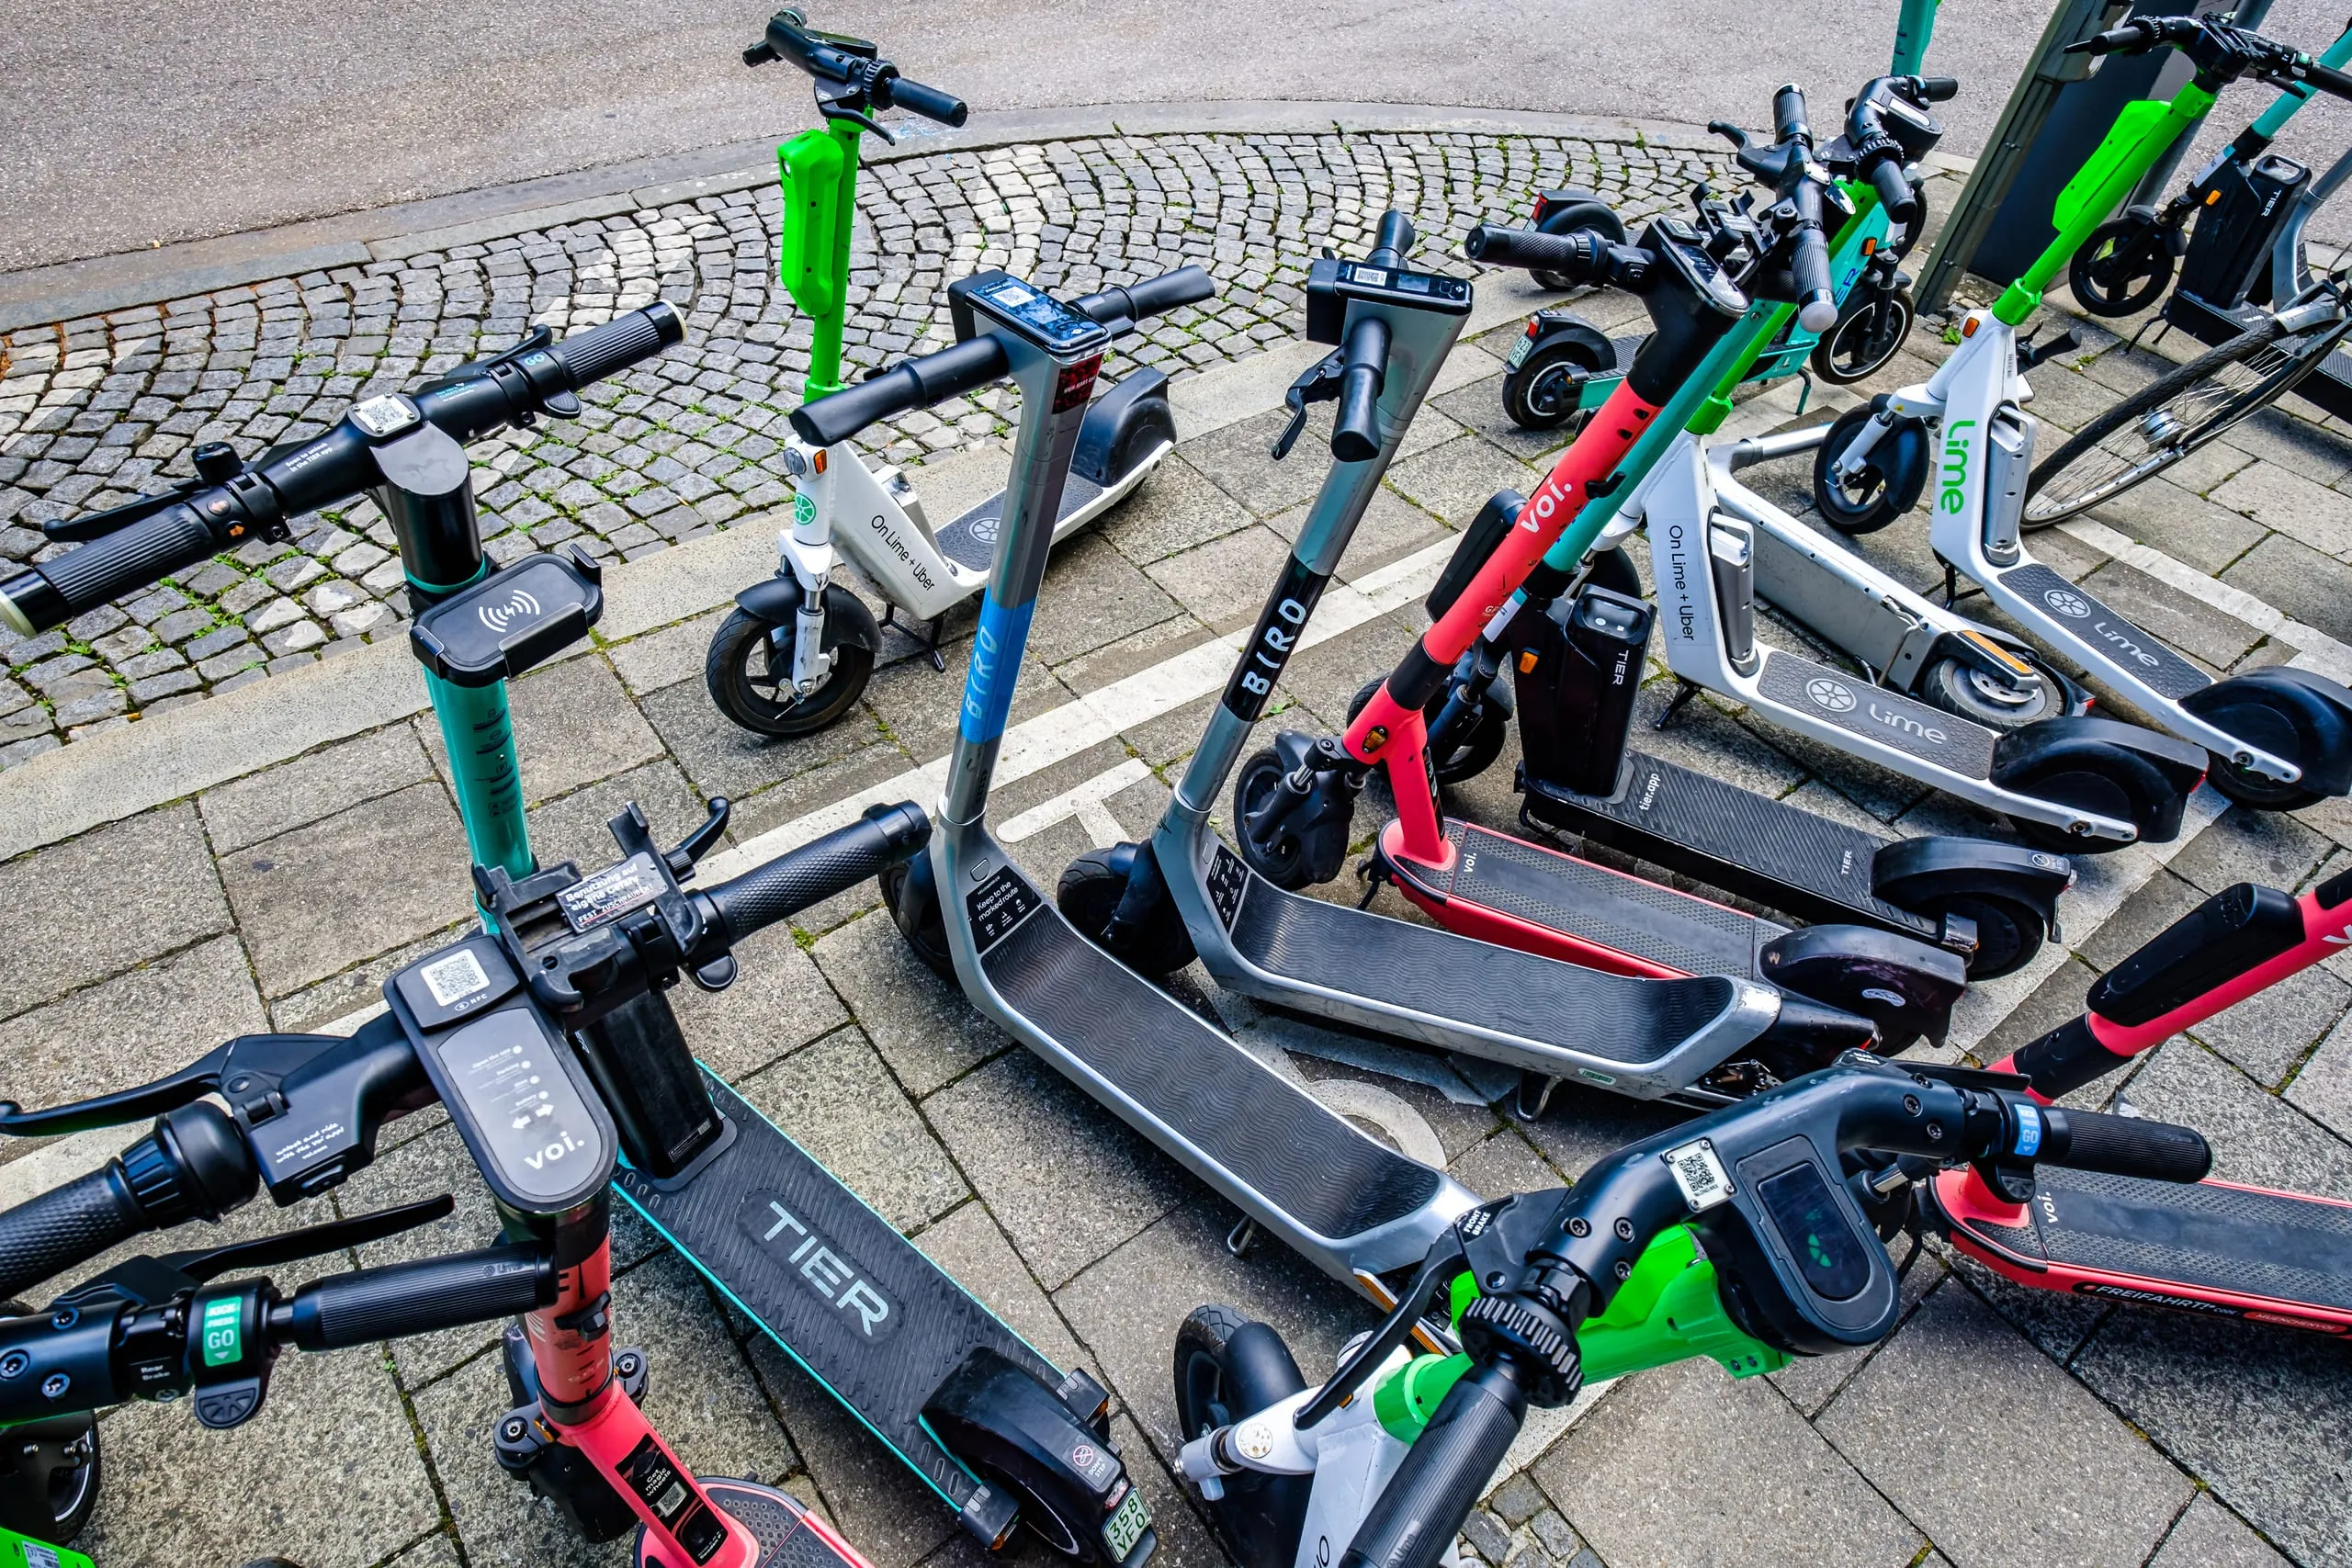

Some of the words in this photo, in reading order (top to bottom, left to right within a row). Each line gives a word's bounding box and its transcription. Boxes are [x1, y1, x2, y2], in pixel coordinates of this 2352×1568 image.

[2260, 189, 2282, 217] TIER
[1835, 268, 1860, 306] ER
[524, 354, 545, 367] GO
[1940, 420, 1976, 514] Lime
[1521, 477, 1572, 534] voi.
[871, 514, 888, 537] On
[1669, 525, 1683, 549] On
[885, 531, 910, 562] Lime
[909, 558, 916, 567] +
[912, 562, 935, 591] Uber
[1671, 553, 1687, 590] Lime
[1679, 593, 1689, 602] +
[1679, 605, 1695, 641] Uber
[1241, 599, 1306, 695] BIRD
[2094, 622, 2159, 667] Lime
[965, 625, 998, 720] BIRD
[1612, 649, 1629, 685] TIER
[1869, 703, 1948, 745] Lime
[1638, 773, 1661, 811] tier.app
[621, 863, 639, 876] auf
[1464, 852, 1477, 873] voi.
[1840, 850, 1852, 875] TIER
[976, 895, 995, 912] Keep
[993, 889, 1001, 898] to
[1000, 881, 1012, 894] the
[978, 898, 1003, 922] marked
[1001, 886, 1019, 903] route
[577, 908, 597, 923] FEST
[469, 993, 488, 1005] NFC
[523, 1131, 585, 1170] voi.
[2022, 1129, 2039, 1144] GO
[1463, 1209, 1482, 1233] FRONT
[2037, 1191, 2058, 1224] voi.
[1472, 1212, 1491, 1236] BRAKE
[763, 1201, 888, 1337] TIER
[208, 1329, 235, 1350] GO
[141, 1364, 164, 1374] Rear
[141, 1371, 171, 1382] Brake
[645, 1468, 667, 1492] magic
[646, 1470, 660, 1483] Get
[646, 1470, 672, 1497] wheels
[1094, 1463, 1107, 1478] STEP
[1109, 1496, 1137, 1540] 358
[1116, 1512, 1146, 1552] YFO
